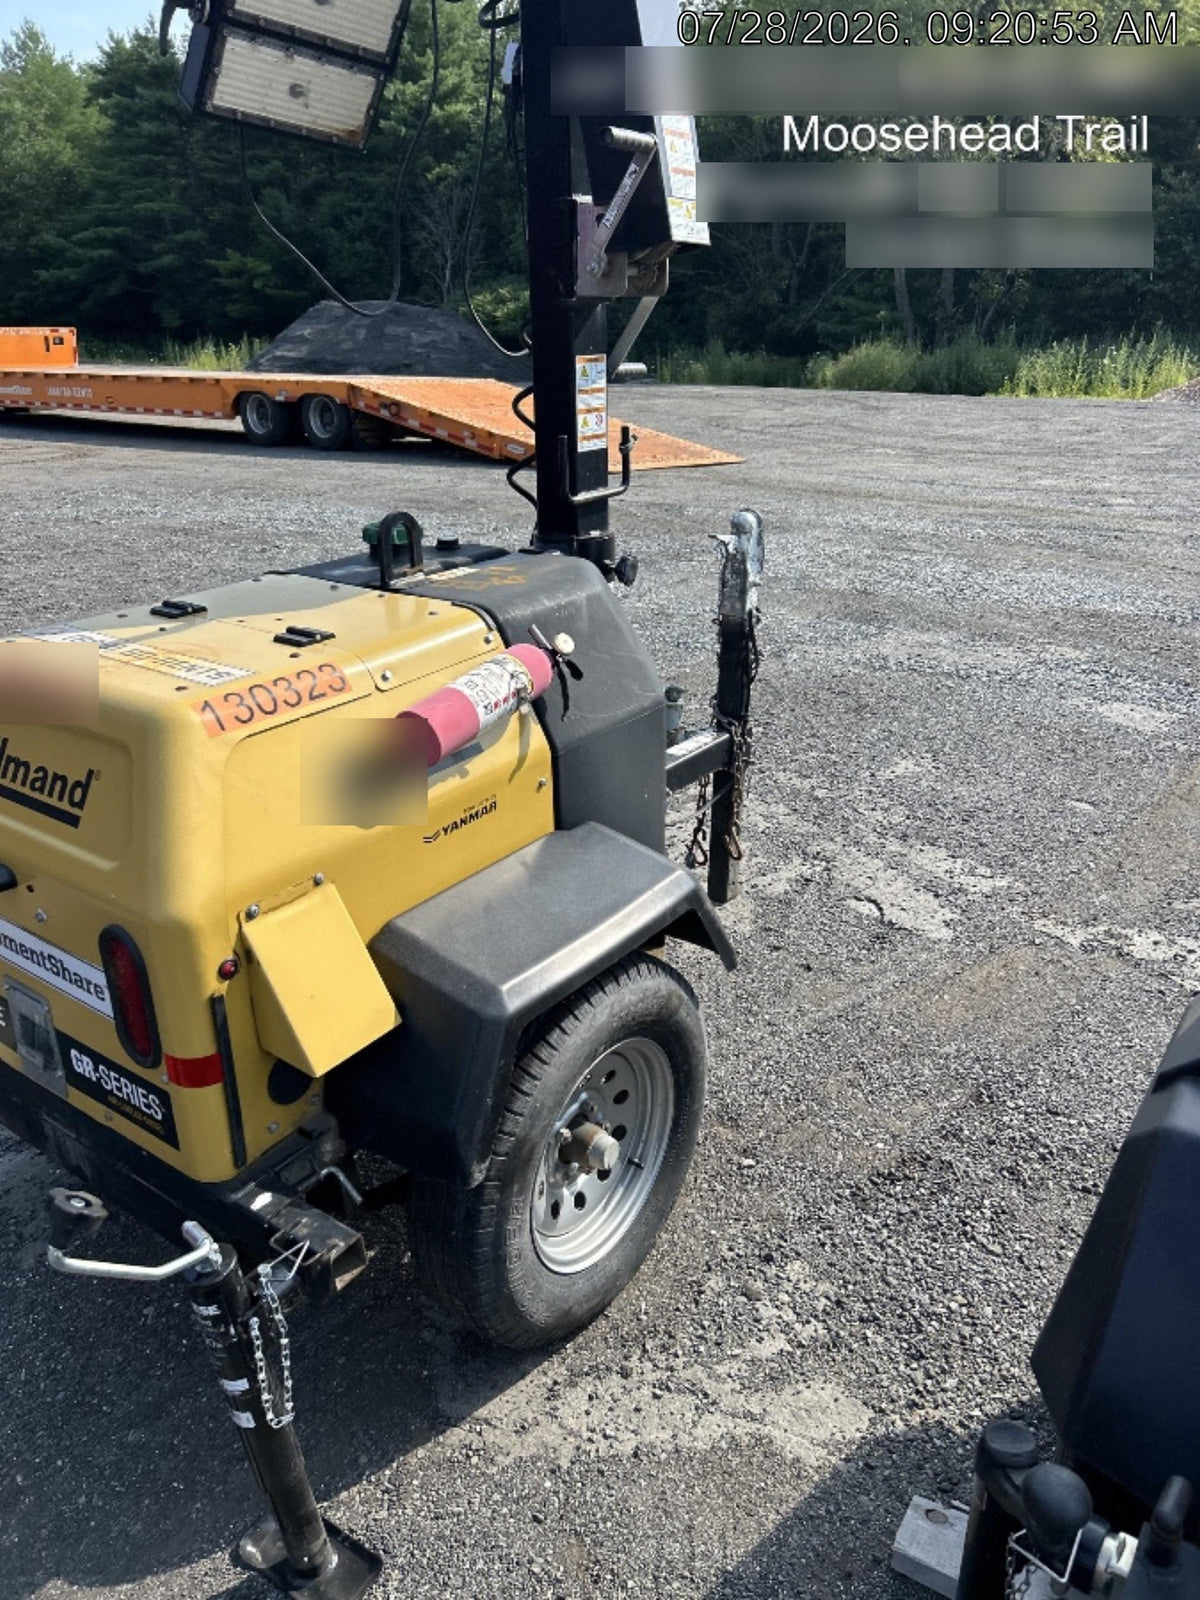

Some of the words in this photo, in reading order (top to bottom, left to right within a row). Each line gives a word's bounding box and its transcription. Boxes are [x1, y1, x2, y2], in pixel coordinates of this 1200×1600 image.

[200, 662, 347, 731] 130323
[441, 800, 497, 836] YANMAR
[0, 932, 106, 1002] mentShare
[70, 1048, 163, 1121] GR-SERIES
